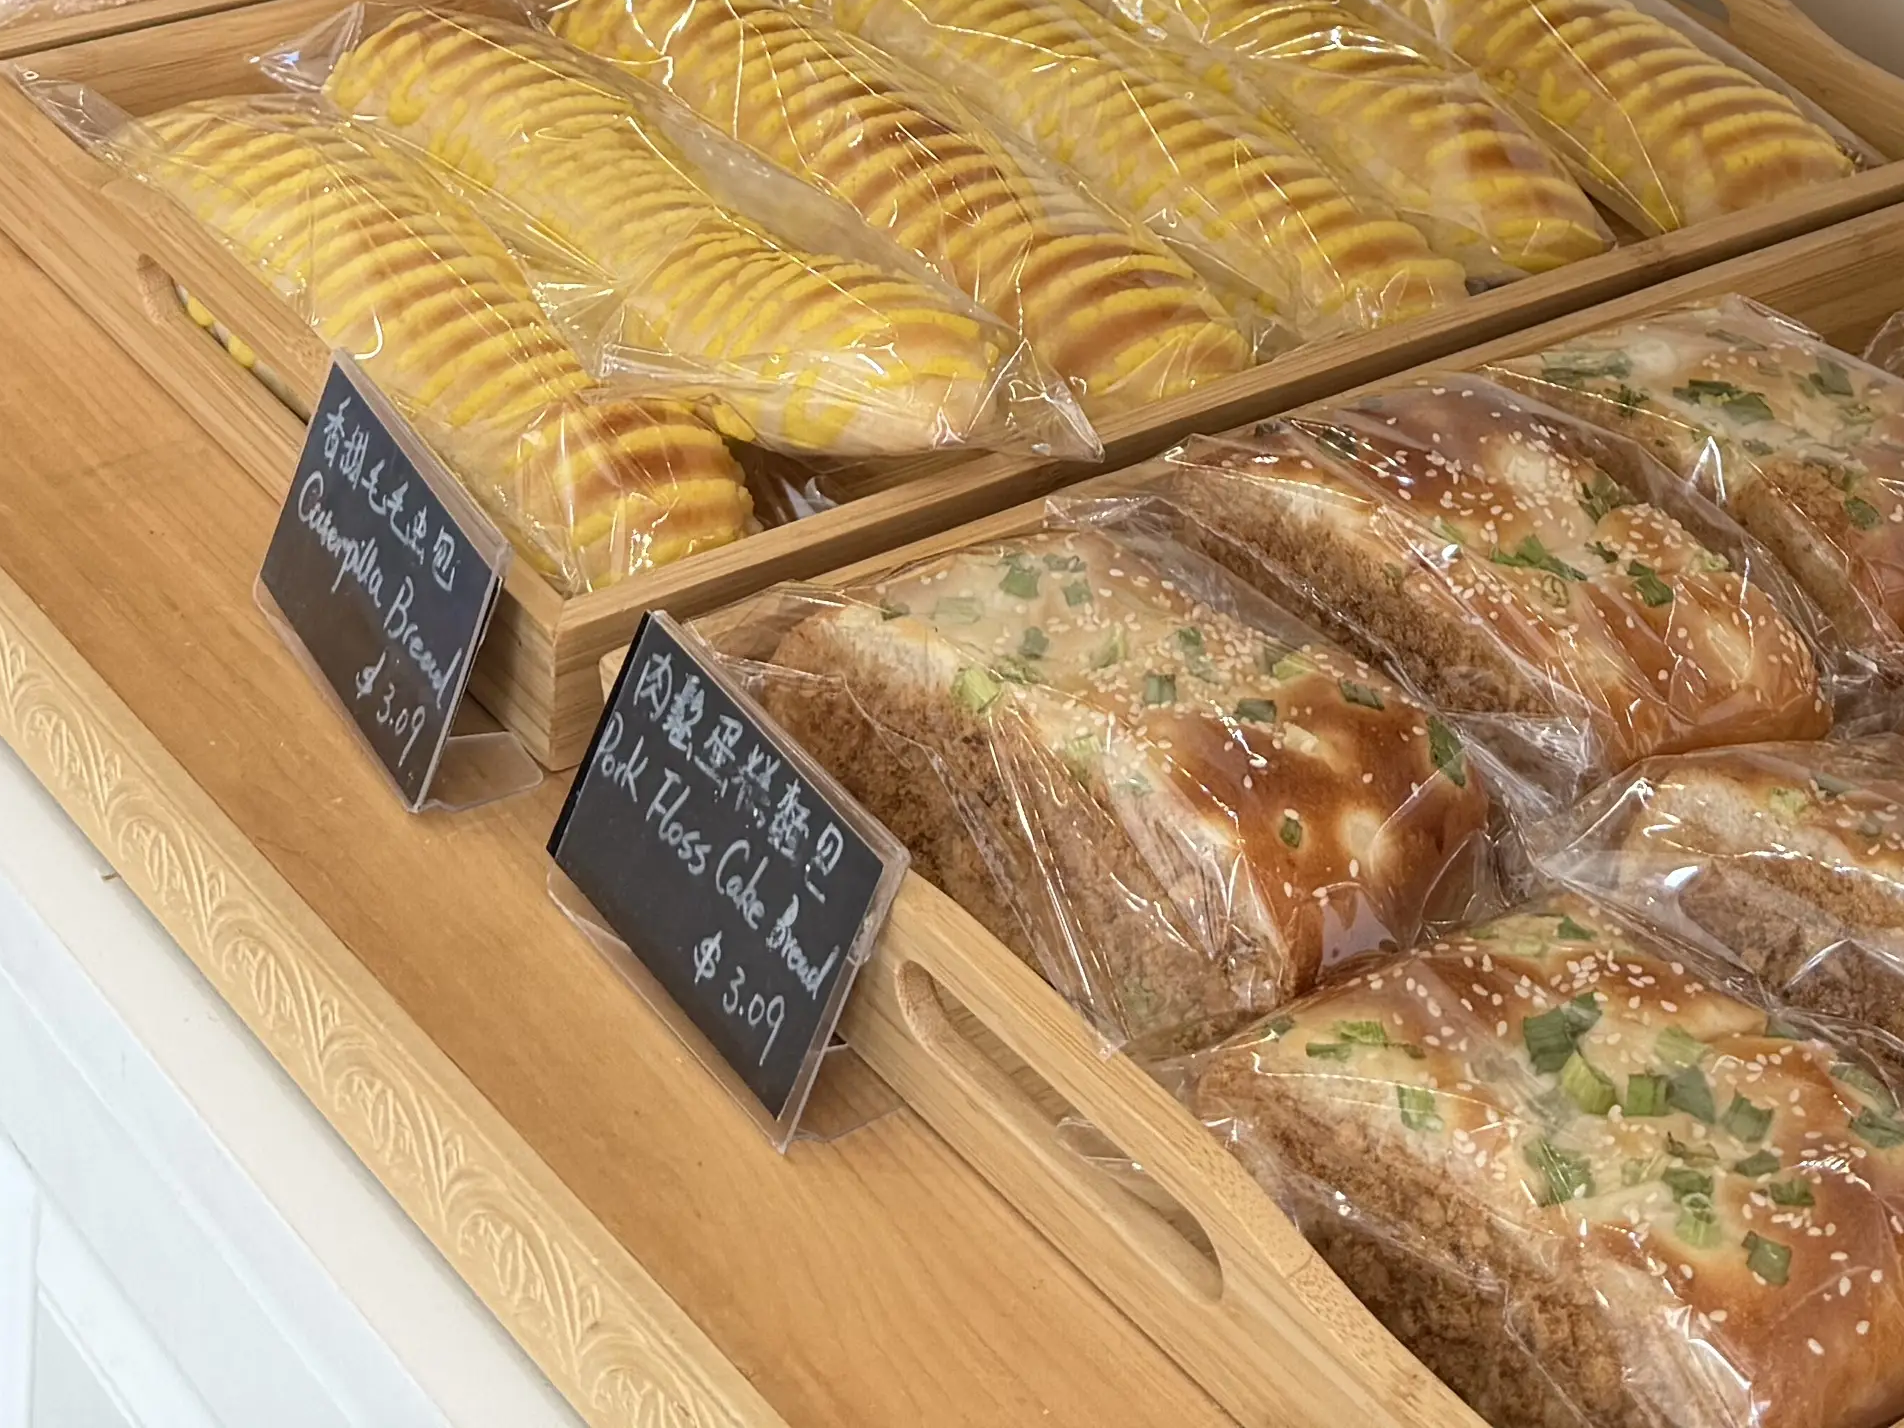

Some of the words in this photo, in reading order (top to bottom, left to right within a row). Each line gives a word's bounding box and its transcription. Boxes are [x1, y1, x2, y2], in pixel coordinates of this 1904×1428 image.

[383, 574, 464, 710] Bread
[595, 711, 650, 803] Pork
[645, 766, 714, 876] Floss
[714, 838, 772, 932] Cake
[765, 893, 840, 1000] Bread
